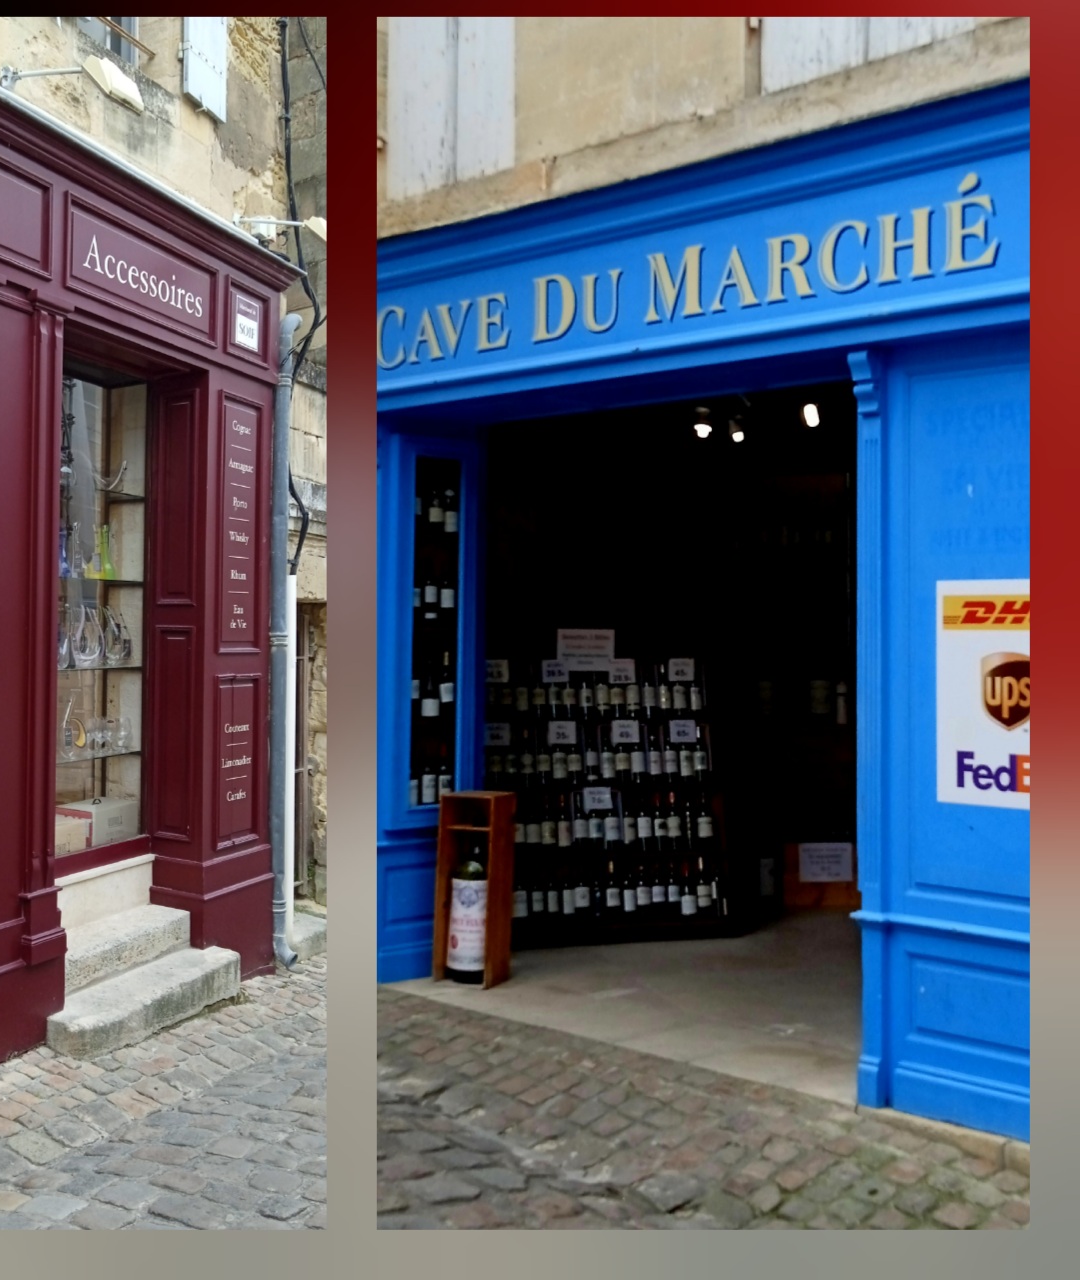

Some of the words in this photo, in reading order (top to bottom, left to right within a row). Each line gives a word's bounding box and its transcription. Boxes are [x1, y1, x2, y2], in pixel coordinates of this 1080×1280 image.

[81, 234, 204, 319] Accessoires
[377, 292, 512, 371] CAVE
[531, 268, 623, 343] DU
[645, 171, 1001, 326] MARCHÉ
[232, 420, 252, 436] Cognac
[228, 457, 254, 474] Armagnac
[229, 531, 250, 546] Whisky
[985, 676, 1030, 719] ups
[224, 723, 250, 734] Couteaux
[221, 755, 252, 769] Limonadier
[226, 788, 247, 802] Carafes
